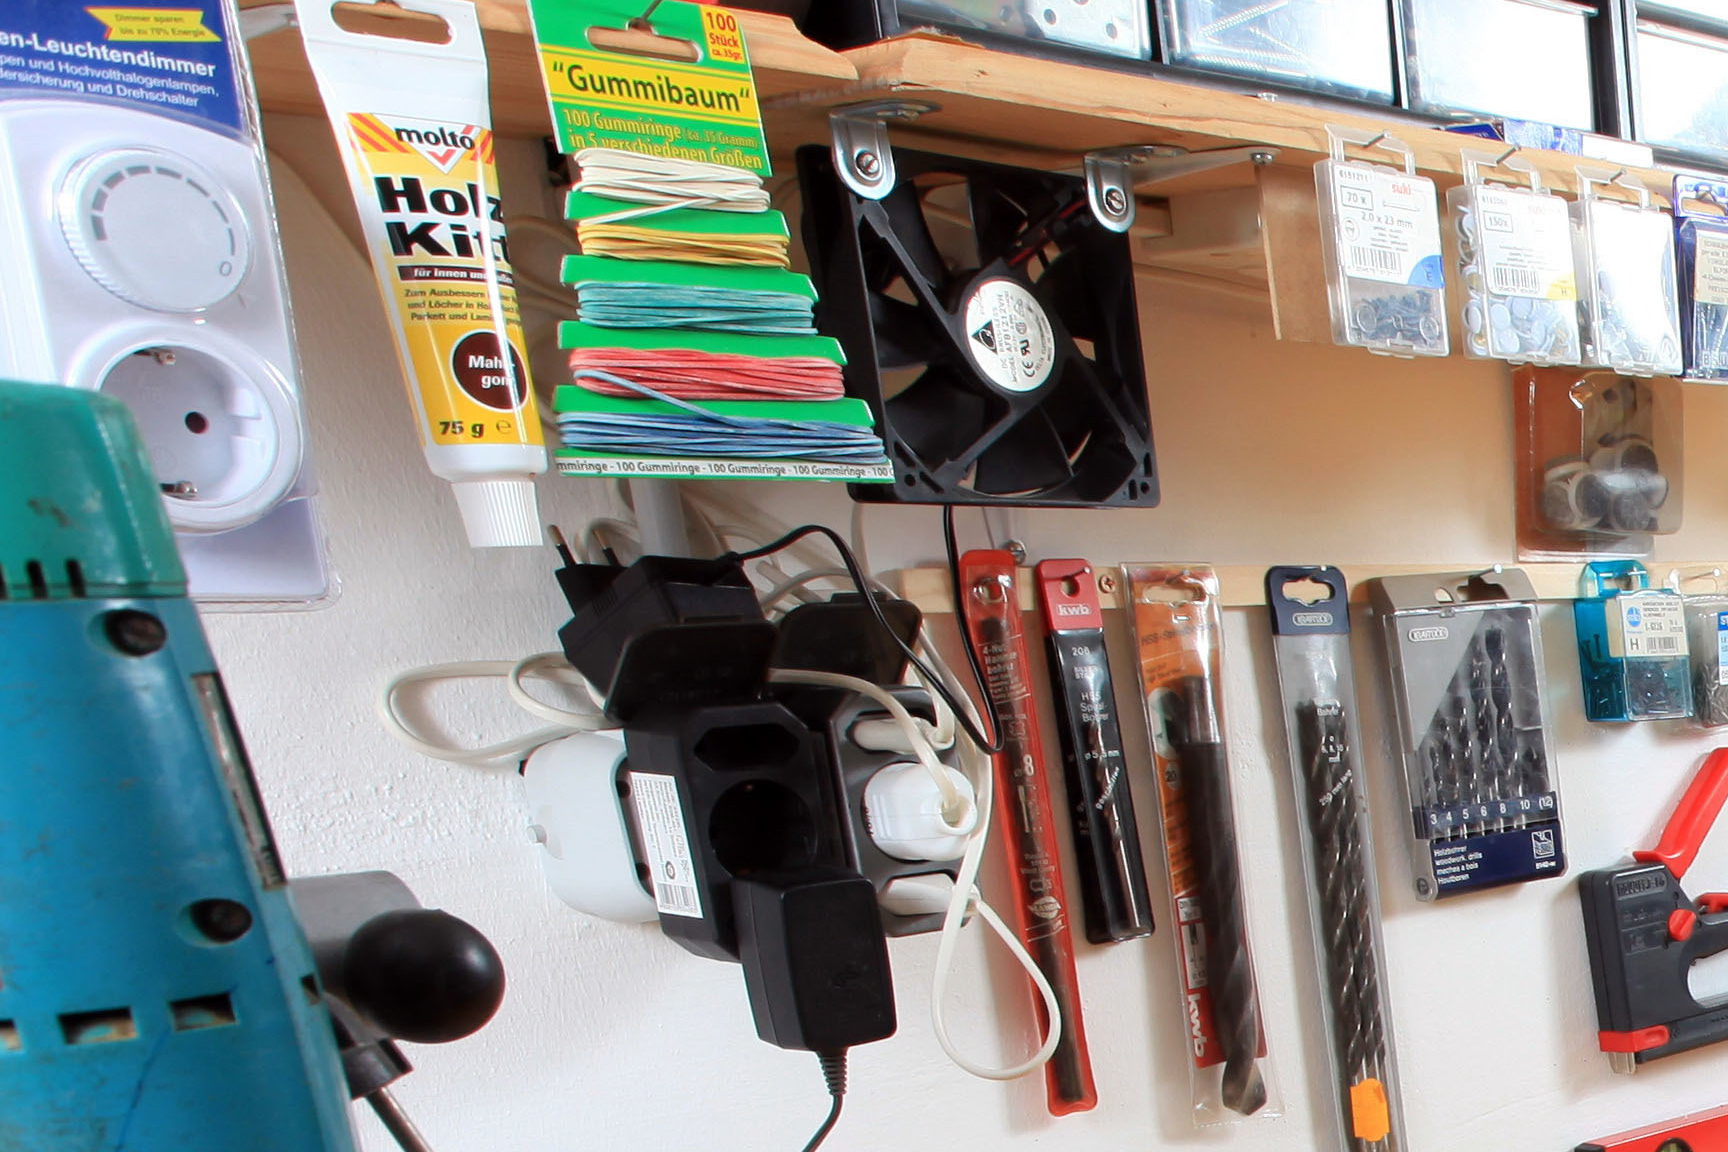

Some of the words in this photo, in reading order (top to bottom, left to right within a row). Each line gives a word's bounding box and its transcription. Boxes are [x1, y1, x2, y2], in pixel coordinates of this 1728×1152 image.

[115, 14, 150, 23] Dimmer
[706, 12, 736, 32] 100
[172, 28, 206, 37] Energie
[709, 32, 740, 49] Stück
[29, 59, 55, 72] und
[58, 63, 220, 97] Hochvolthalogenlampen,
[88, 82, 113, 96] und
[116, 84, 200, 107] Drehschalter
[563, 109, 591, 129] 100
[593, 112, 682, 142] Gummiringe
[394, 125, 475, 151] molto
[569, 129, 587, 149] in
[589, 132, 598, 150] 5
[599, 136, 708, 162] verschiedenen
[710, 146, 763, 170] Größen
[1392, 183, 1411, 195] suki
[414, 268, 431, 278] für
[434, 268, 468, 279] innen
[439, 421, 464, 435] 75
[470, 422, 485, 438] g
[616, 461, 636, 473] 100
[637, 462, 701, 476] Gummiringe
[708, 463, 726, 475] 100
[727, 463, 787, 478] Gummiringe
[793, 465, 810, 476] 100
[811, 465, 866, 479] Gummiringe
[873, 467, 889, 478] 100
[1057, 603, 1092, 617] kwb
[1629, 638, 1640, 651] H
[1023, 754, 1034, 776] 8
[1430, 814, 1437, 825] 3
[1446, 811, 1453, 822] 4
[1462, 809, 1469, 820] 5
[1480, 806, 1487, 817] 6
[1500, 802, 1506, 814] 8
[1520, 799, 1530, 811] 10
[1187, 993, 1208, 1058] kwb
